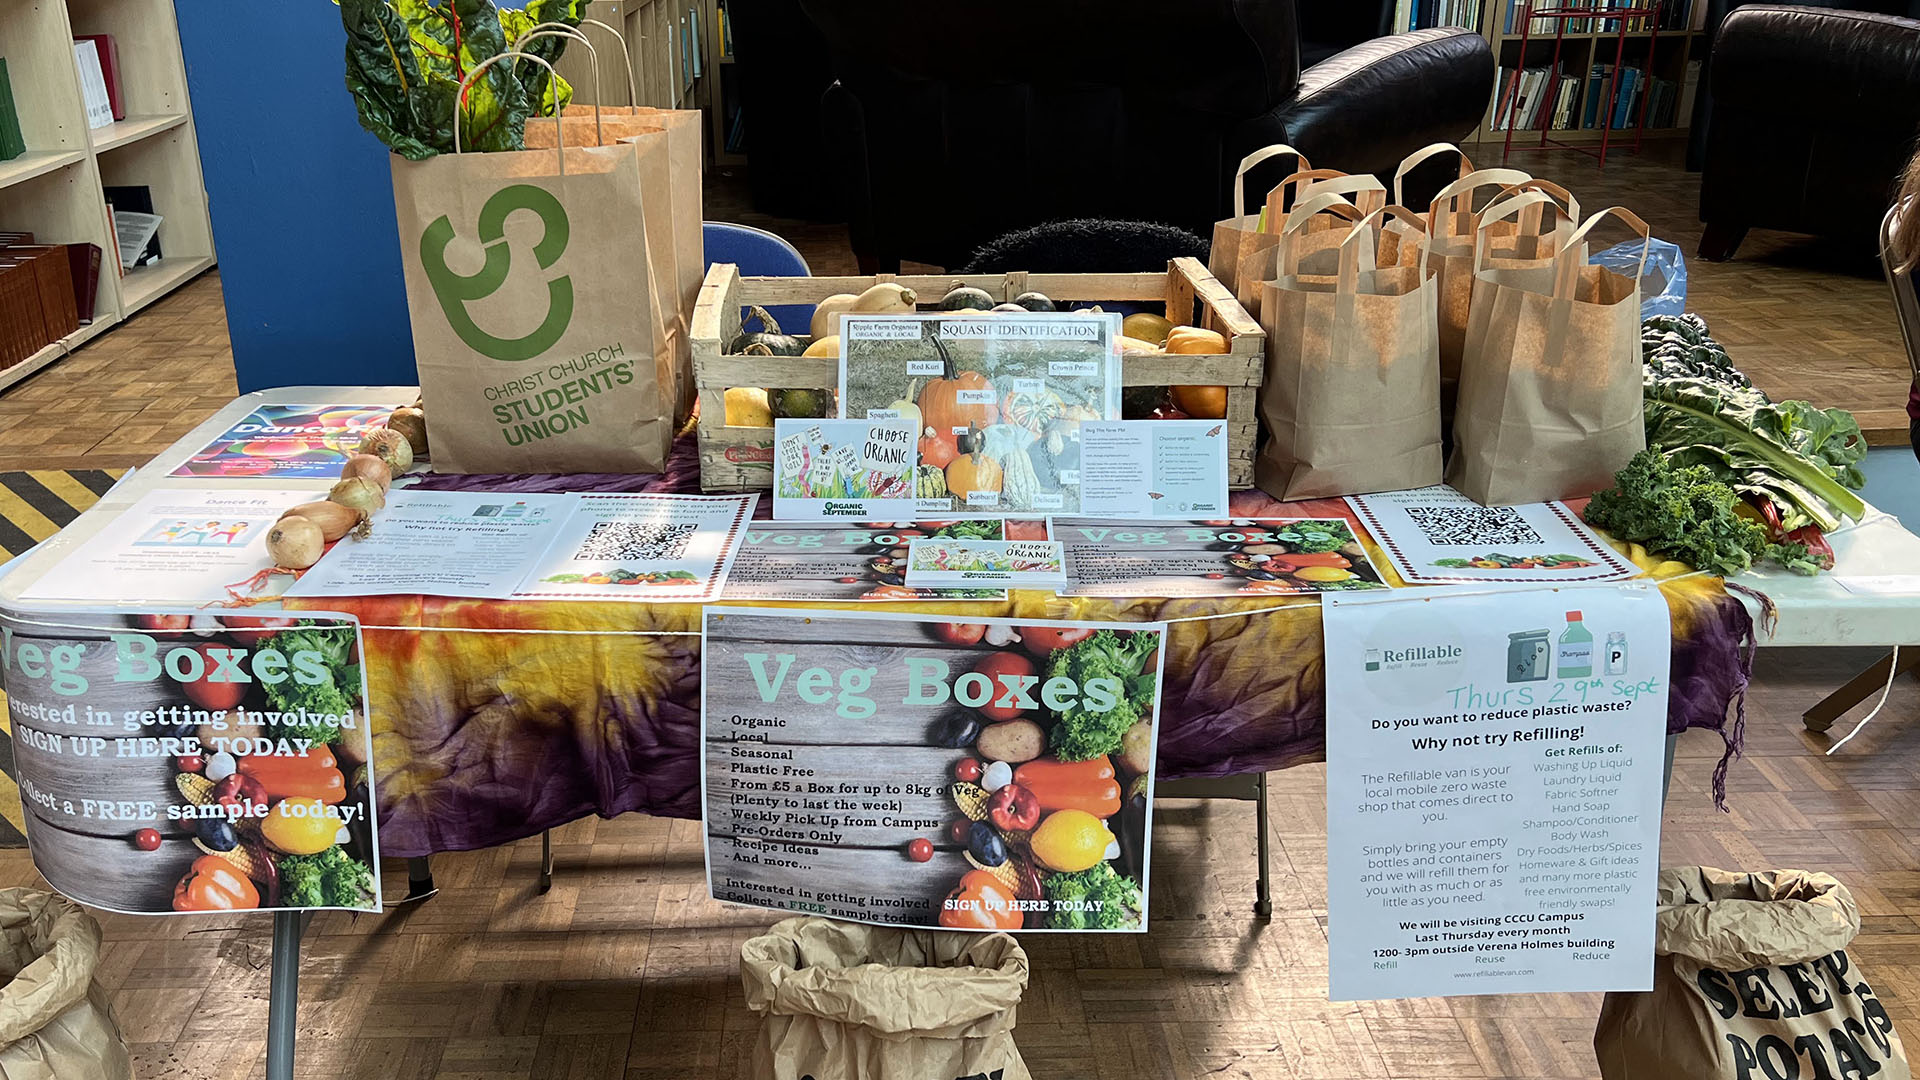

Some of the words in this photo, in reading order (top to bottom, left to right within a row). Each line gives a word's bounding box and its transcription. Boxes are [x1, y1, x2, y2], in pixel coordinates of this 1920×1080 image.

[943, 325, 992, 335] SQUASH
[998, 325, 1095, 336] IDENTIFICATION
[484, 371, 544, 400] CHRIST
[549, 342, 624, 380] CHURCH
[912, 363, 923, 371] Red
[925, 363, 939, 371] Kuri
[963, 392, 990, 401] Pumpkin
[869, 411, 898, 420] Spaghetti
[232, 424, 339, 433] Dance
[502, 405, 590, 446] UNION
[870, 428, 909, 443] CHOOSE
[864, 441, 906, 463] ORGANIC
[825, 502, 863, 511] ORGANIC
[921, 500, 949, 508] Dumpling
[746, 532, 824, 547] Veg
[1077, 528, 1170, 545] Veg
[1185, 529, 1334, 544] Boxes
[1006, 550, 1052, 559] ORGANIC
[110, 634, 332, 685] Boxes
[1383, 645, 1462, 663] Refillable
[1611, 652, 1621, 663] P
[744, 653, 878, 720] Veg
[903, 657, 1117, 712] Boxes
[1446, 684, 1533, 709] Thurs
[1612, 677, 1661, 700] Sept
[10, 696, 77, 725] erested
[86, 705, 114, 726] in
[123, 705, 228, 730] getting
[237, 705, 356, 729] involved
[731, 715, 786, 728] Organic
[1372, 720, 1389, 729] Do
[1393, 718, 1419, 731] you
[1423, 714, 1458, 725] want
[1462, 712, 1477, 722] to
[1481, 708, 1528, 721] reduce
[1532, 703, 1579, 719] plastic
[1582, 700, 1632, 713] waste?
[20, 726, 62, 754] SIGN
[69, 737, 107, 758] UP
[115, 738, 202, 758] HERE
[211, 737, 313, 758] TODAY
[731, 731, 768, 742] Local
[1413, 737, 1446, 752] Why
[1452, 735, 1480, 747] not
[1485, 733, 1508, 749] try
[1513, 726, 1585, 746] Refilling!
[731, 747, 793, 760] Seasonal
[1545, 748, 1566, 757] Get
[1569, 745, 1604, 756] Refills
[1607, 744, 1623, 754] of:
[731, 763, 778, 775] Plastic
[783, 766, 814, 776] Free
[1362, 774, 1384, 785] The
[1387, 770, 1442, 783] Refillable
[1445, 769, 1467, 779] van
[1470, 767, 1480, 777] is
[1482, 765, 1512, 779] your
[731, 779, 767, 790] From
[772, 781, 790, 791] £5
[808, 783, 834, 793] Box
[839, 783, 859, 794] for
[864, 786, 880, 796] up
[887, 786, 899, 794] to
[906, 784, 931, 797] 8kg
[936, 785, 949, 795] of
[954, 784, 980, 797] Veg
[63, 801, 75, 816] a
[81, 800, 158, 820] FREE
[167, 799, 269, 823] sample
[278, 799, 365, 821] today!
[731, 794, 780, 808] (Plenty
[785, 798, 798, 808] to
[803, 799, 828, 809] last
[834, 800, 856, 810] the
[862, 800, 902, 813] week)
[732, 809, 780, 824] Weekly
[785, 813, 816, 824] Pick
[821, 816, 838, 828] Up
[844, 816, 877, 827] from
[882, 817, 938, 830] Campus
[732, 824, 804, 839] Pre-Orders
[810, 830, 842, 844] Only
[732, 839, 778, 853] Recipe
[783, 844, 819, 855] Ideas
[733, 852, 759, 864] And
[764, 858, 811, 870] more...
[726, 878, 794, 897] Interested
[799, 888, 812, 898] in
[817, 891, 866, 907] getting
[871, 896, 930, 909] involved
[727, 891, 773, 907] Collect
[778, 900, 785, 908] a
[790, 900, 827, 913] FREE
[831, 907, 879, 921] sample
[884, 911, 929, 924] today!
[944, 900, 980, 911] SIGN
[984, 900, 1005, 911] UP
[1008, 900, 1049, 911] HERE
[1053, 901, 1104, 912] TODAY
[1400, 920, 1417, 931] We
[1421, 918, 1440, 929] will
[1443, 917, 1457, 928] be
[1460, 914, 1501, 928] visiting
[1504, 913, 1535, 924] CCCU
[1538, 911, 1585, 925] Campus
[1415, 932, 1439, 943] Last
[1442, 928, 1494, 943] Thursday
[1497, 927, 1529, 939] every
[1533, 925, 1571, 936] month
[1373, 948, 1402, 958] 1200-
[1405, 946, 1430, 959] 3pm
[1433, 943, 1474, 955] outside
[1477, 941, 1517, 952] Verena
[1520, 939, 1564, 950] Holmes
[1567, 937, 1615, 950] building
[1373, 959, 1398, 970] Refill
[1475, 954, 1505, 965] Reuse
[1573, 951, 1610, 961] Reduce
[1454, 968, 1535, 979] www.refillablevan.com
